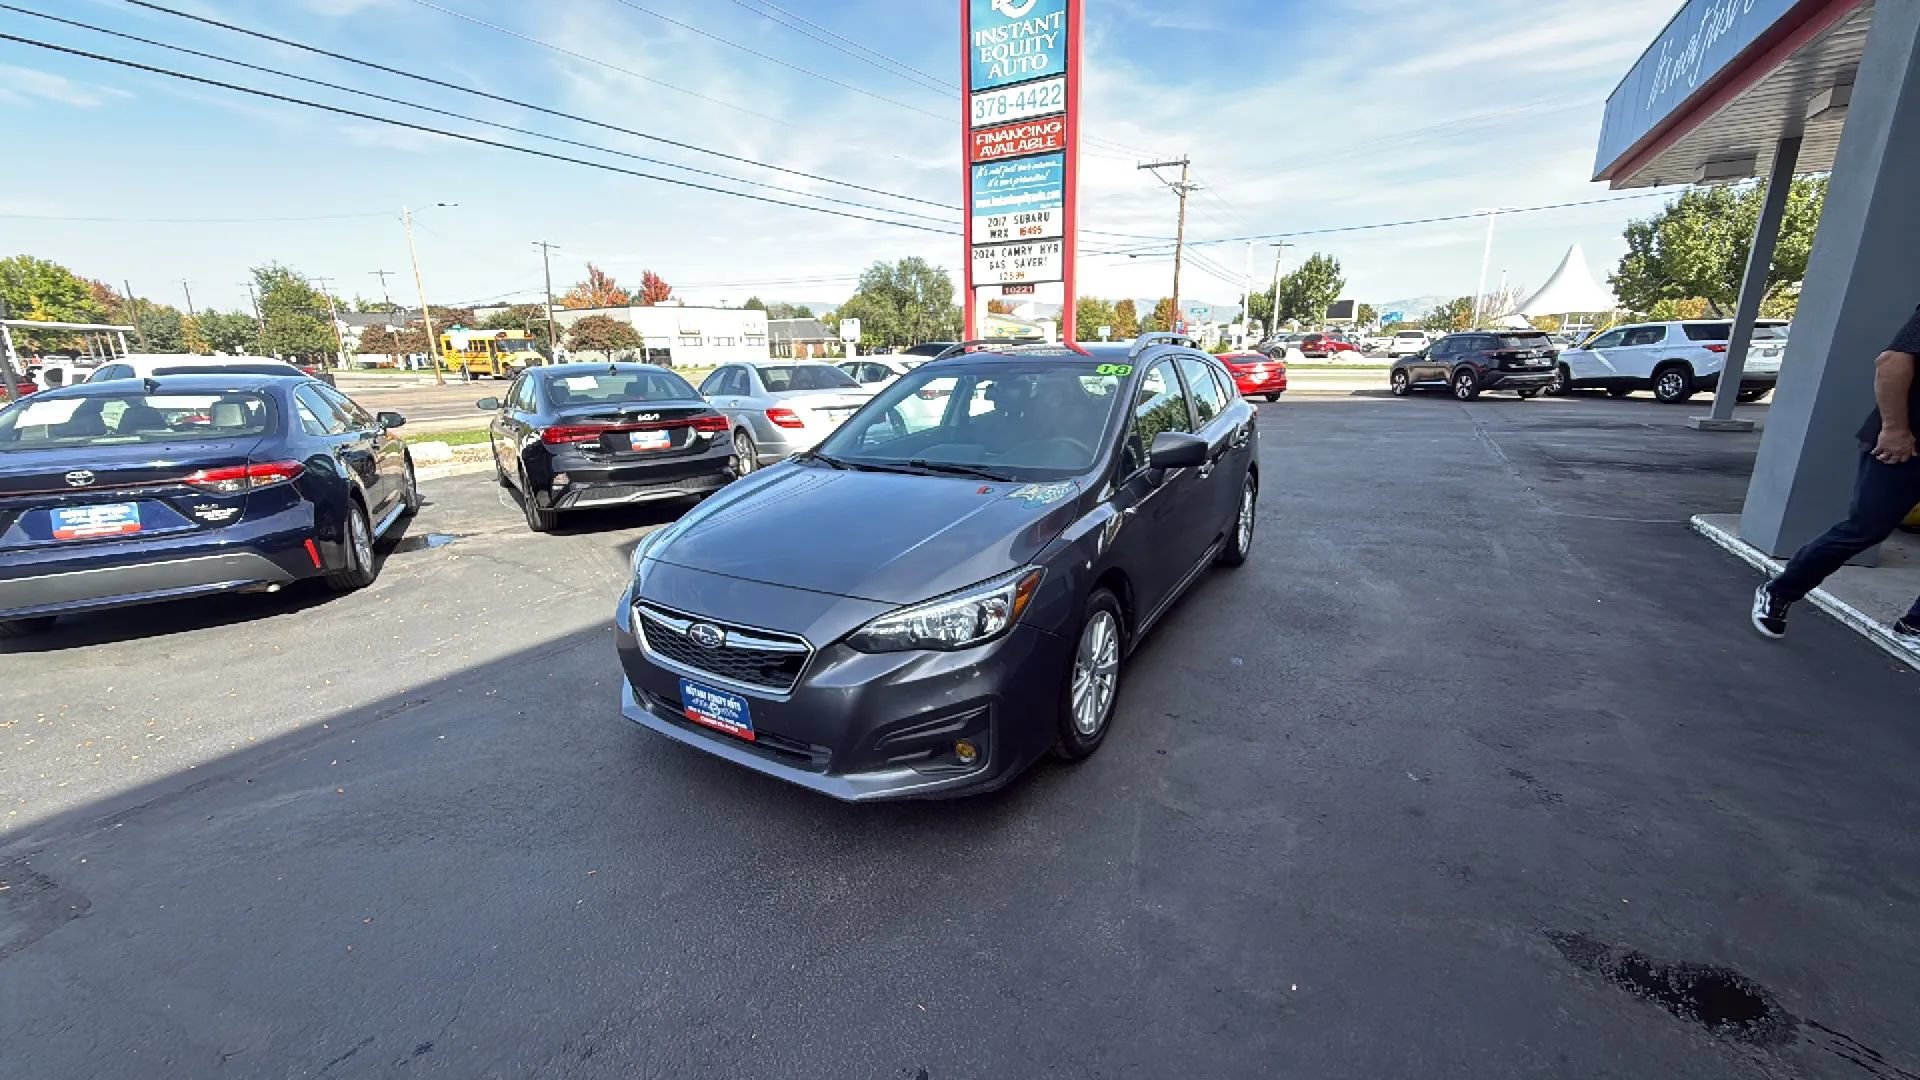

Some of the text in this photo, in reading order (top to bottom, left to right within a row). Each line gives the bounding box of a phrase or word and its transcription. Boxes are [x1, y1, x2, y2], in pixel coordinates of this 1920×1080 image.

[975, 11, 1065, 47] INSTANT
[980, 31, 1059, 63] EQUITY
[988, 54, 1049, 79] AUTO
[975, 83, 1062, 119] 378-4422
[975, 121, 1062, 145] FINANCING
[979, 135, 1057, 156] AVAILABLE
[987, 211, 1051, 228] 2017 SUBARU
[989, 228, 1009, 239] WRX
[973, 249, 996, 260] 2024
[1001, 245, 1033, 258] CAMRY
[989, 260, 1006, 271] GAS
[1004, 285, 1034, 294] 10221
